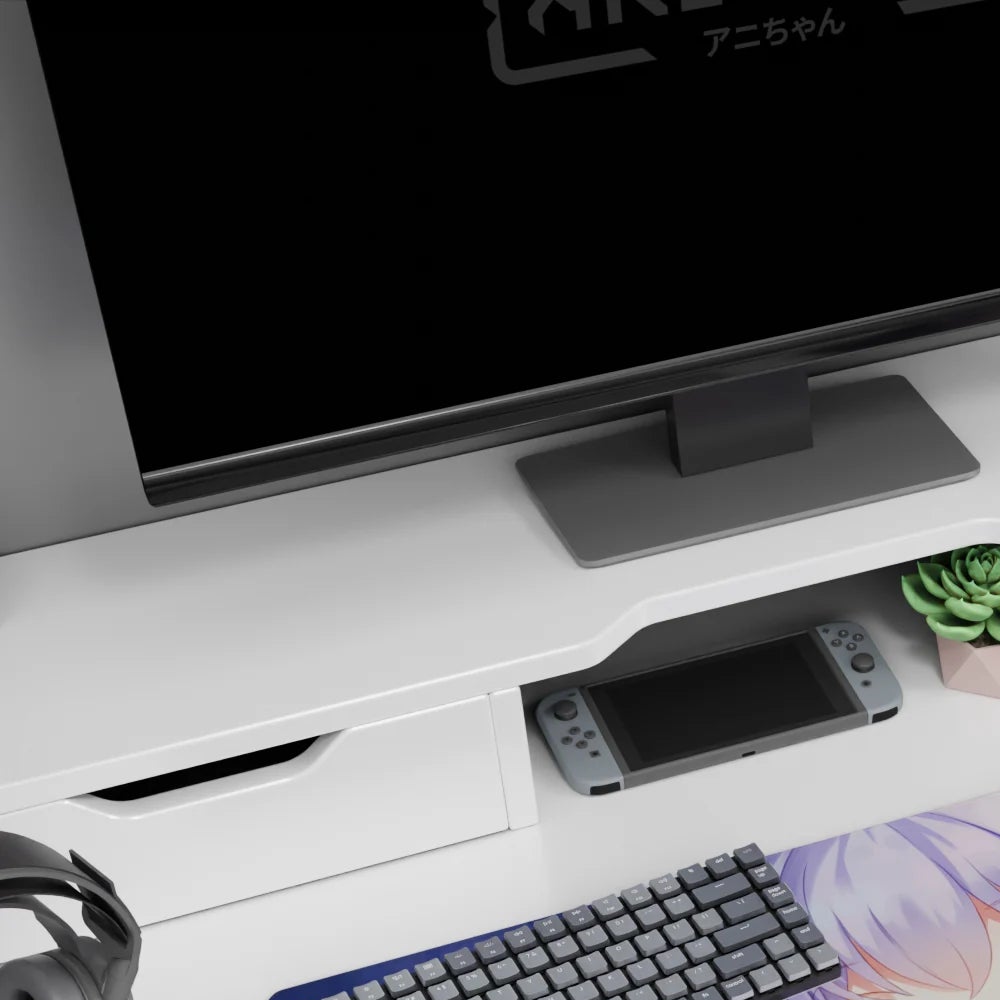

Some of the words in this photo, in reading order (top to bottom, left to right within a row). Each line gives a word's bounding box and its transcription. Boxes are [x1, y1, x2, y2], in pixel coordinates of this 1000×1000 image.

[703, 8, 846, 58] アニちゃん
[782, 906, 798, 915] home
[731, 951, 744, 960] shift
[725, 978, 744, 989] control
